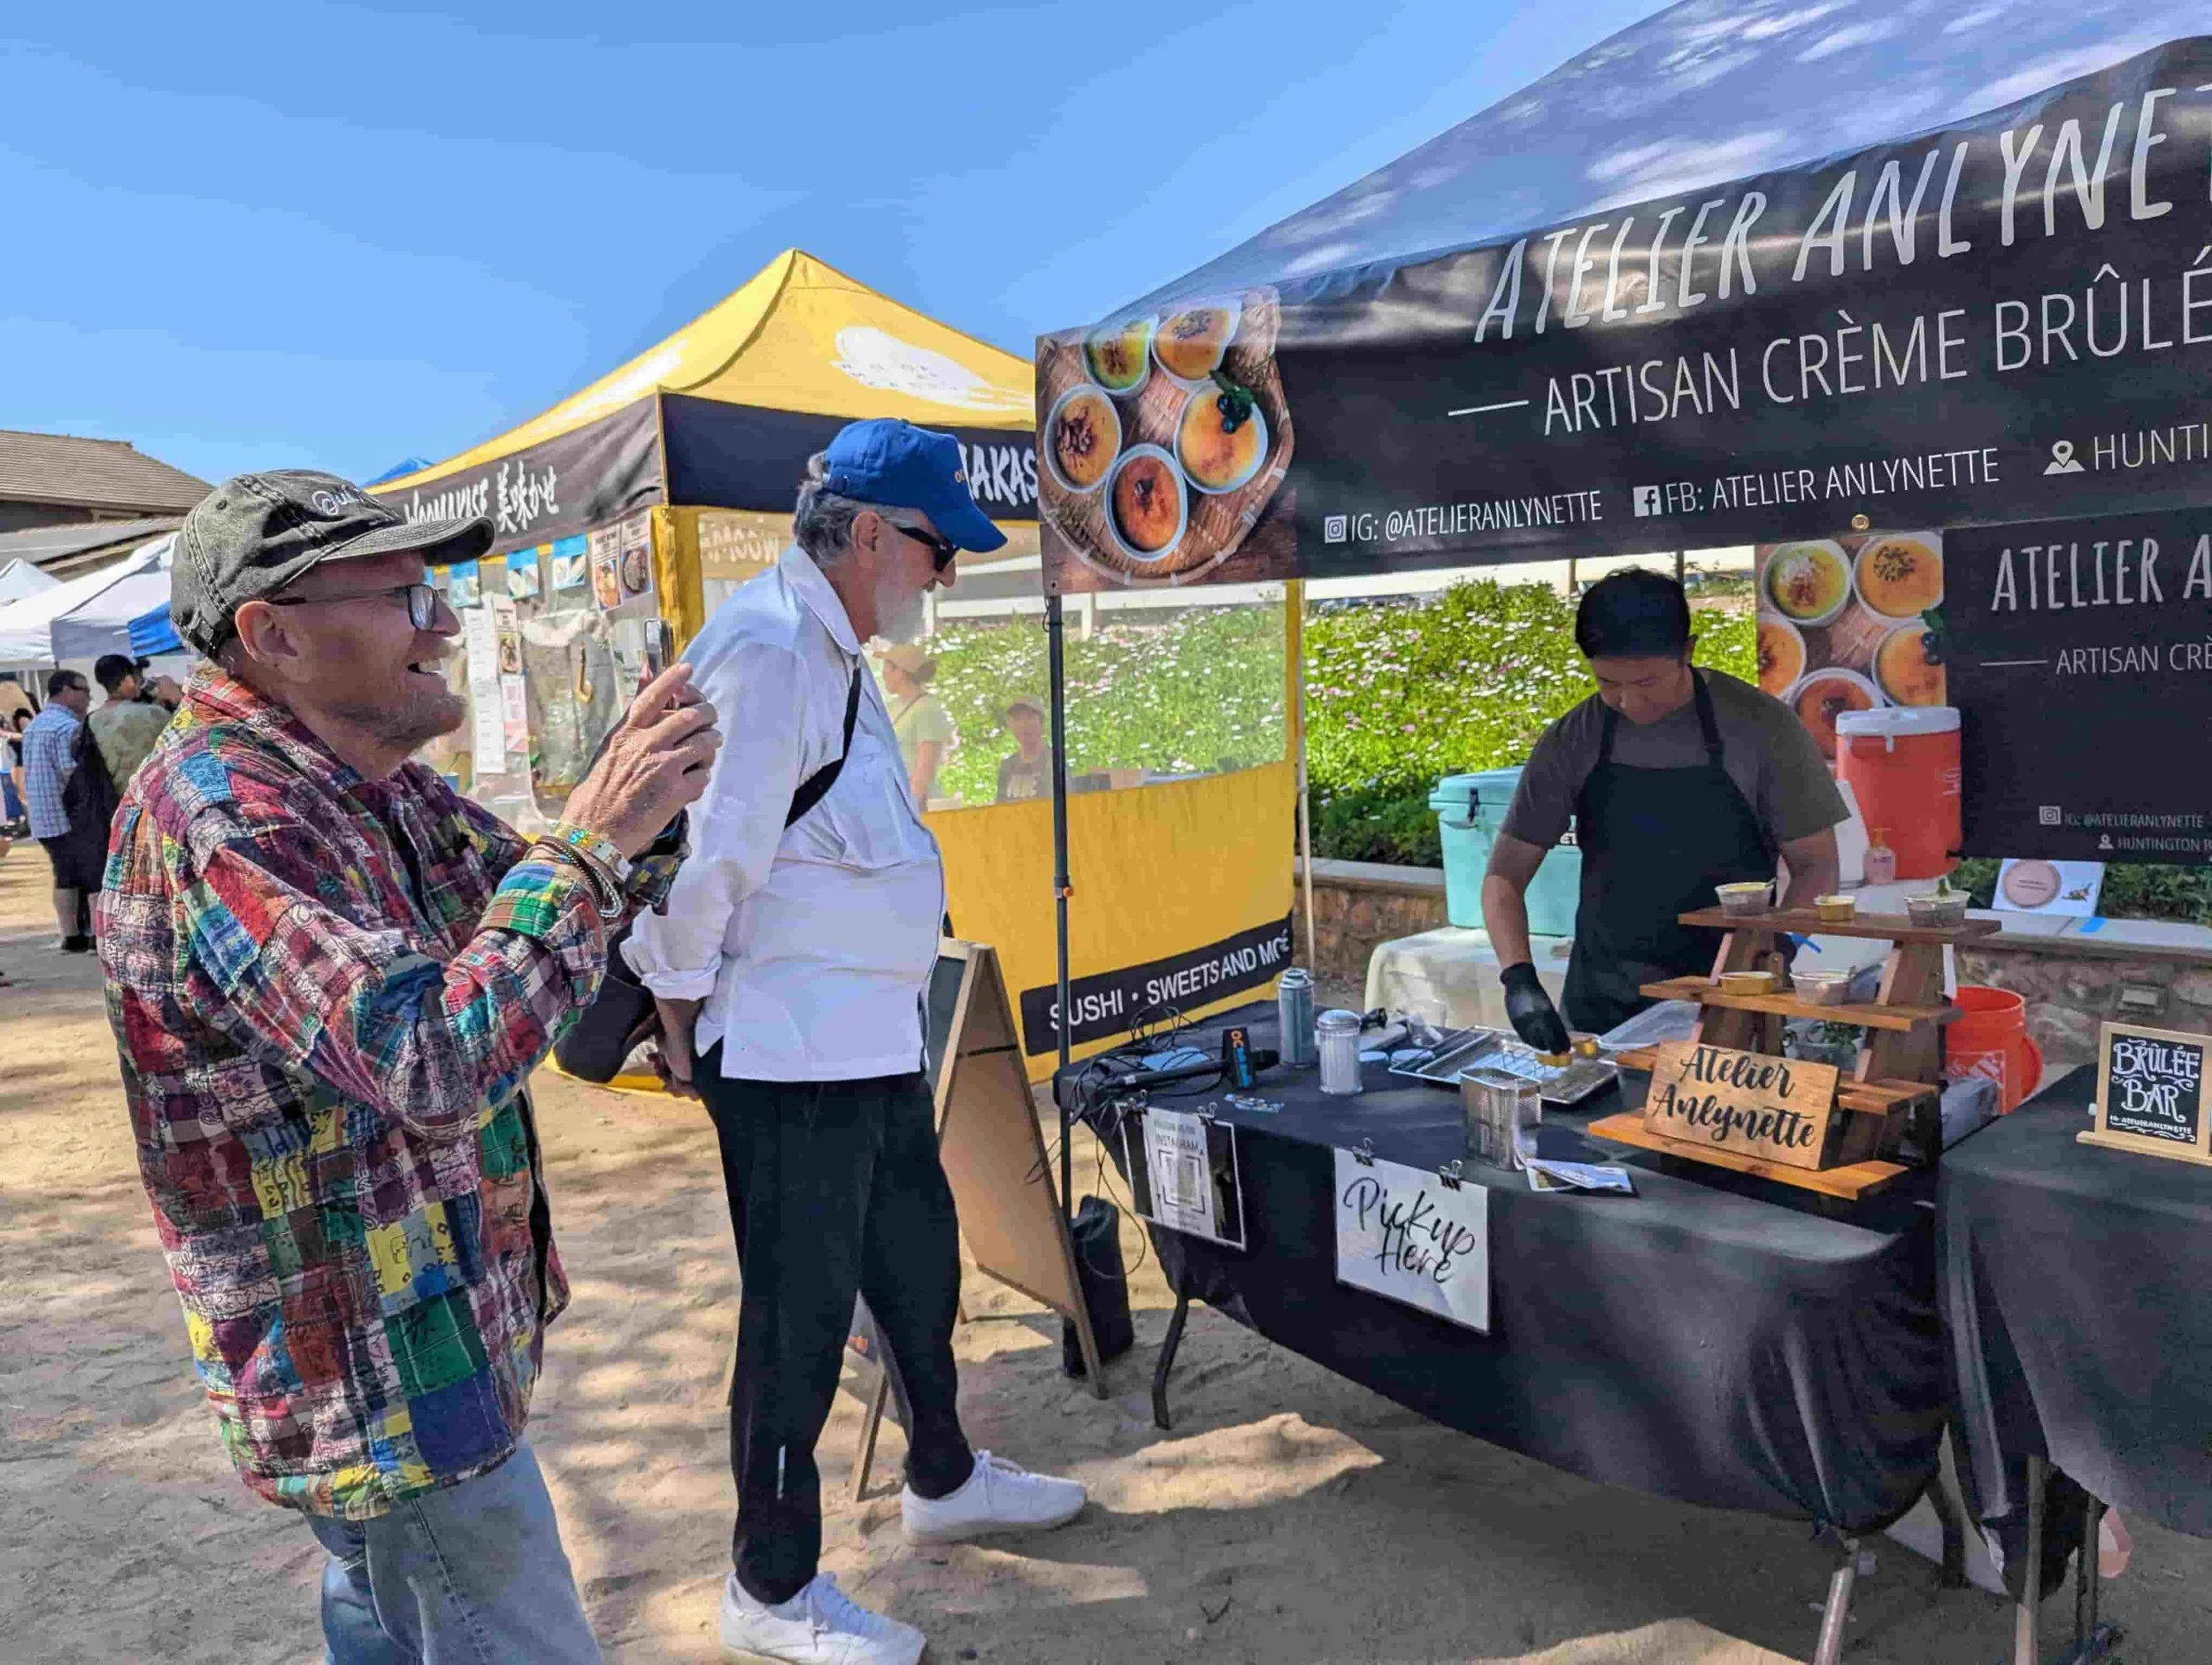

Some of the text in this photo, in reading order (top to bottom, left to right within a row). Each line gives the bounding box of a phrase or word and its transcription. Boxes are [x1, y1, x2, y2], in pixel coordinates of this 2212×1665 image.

[1474, 84, 2212, 343] ATELIER ANLYNE
[1544, 245, 2212, 436] ARTISAN CRÈME BRÛLÉ
[958, 443, 1038, 508] AKAS
[1664, 481, 1705, 514] FB:
[1711, 468, 1817, 510] ATELIER
[1825, 447, 2001, 500] ANLYNETTE
[1351, 489, 1604, 542] IG: @ATELIERANLYNETTE
[1991, 533, 2212, 611] ATELIER A
[2055, 645, 2160, 675] ARTISAN
[1146, 960, 1220, 1006] SWEETS
[1220, 947, 1257, 981] AND
[1678, 1045, 1796, 1099] Atelier
[2121, 1078, 2187, 1124] BAR
[1652, 1083, 1817, 1148] Anlynette
[1374, 1225, 1455, 1284] Here
